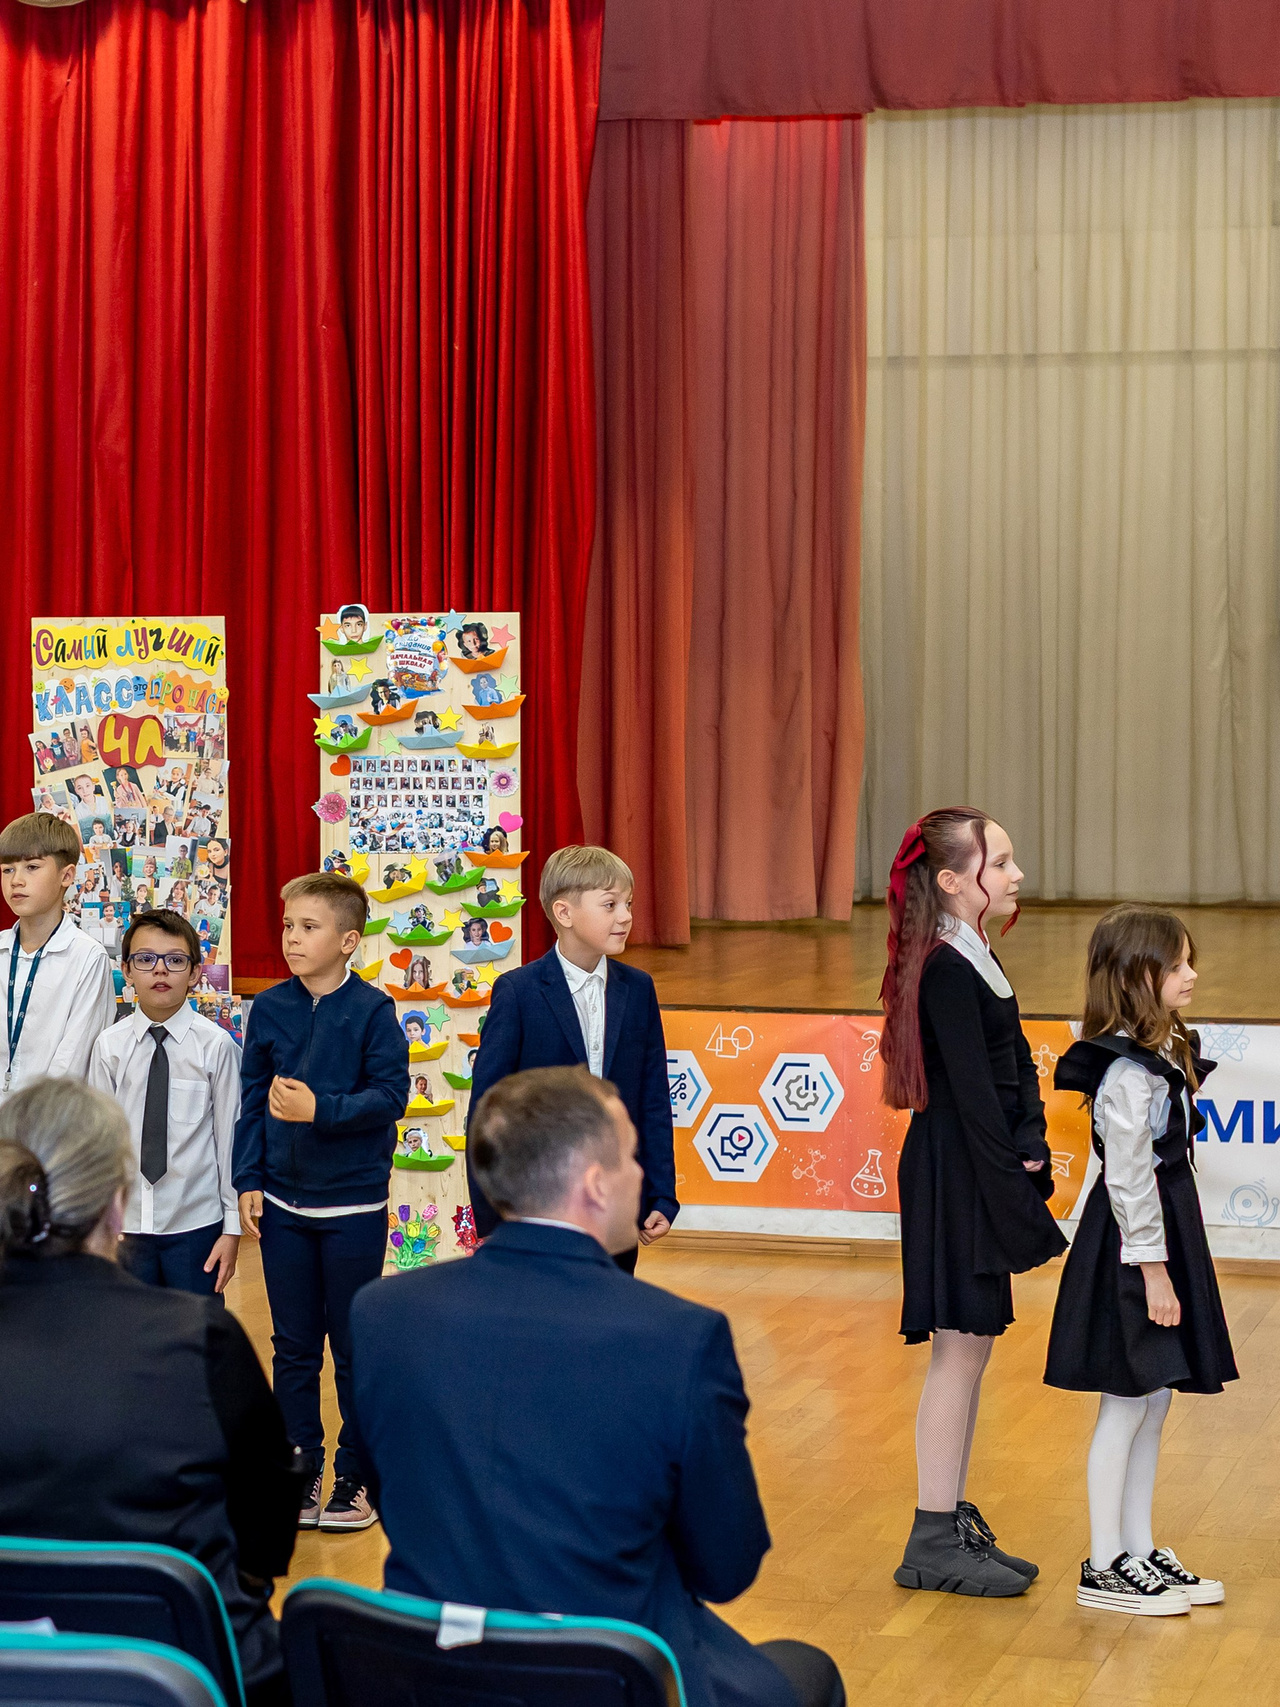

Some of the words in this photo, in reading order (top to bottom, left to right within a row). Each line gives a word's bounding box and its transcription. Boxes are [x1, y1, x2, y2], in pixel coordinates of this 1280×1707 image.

[35, 628, 108, 666] Самый
[116, 627, 221, 667] лучший
[35, 675, 134, 722] КЛАСС
